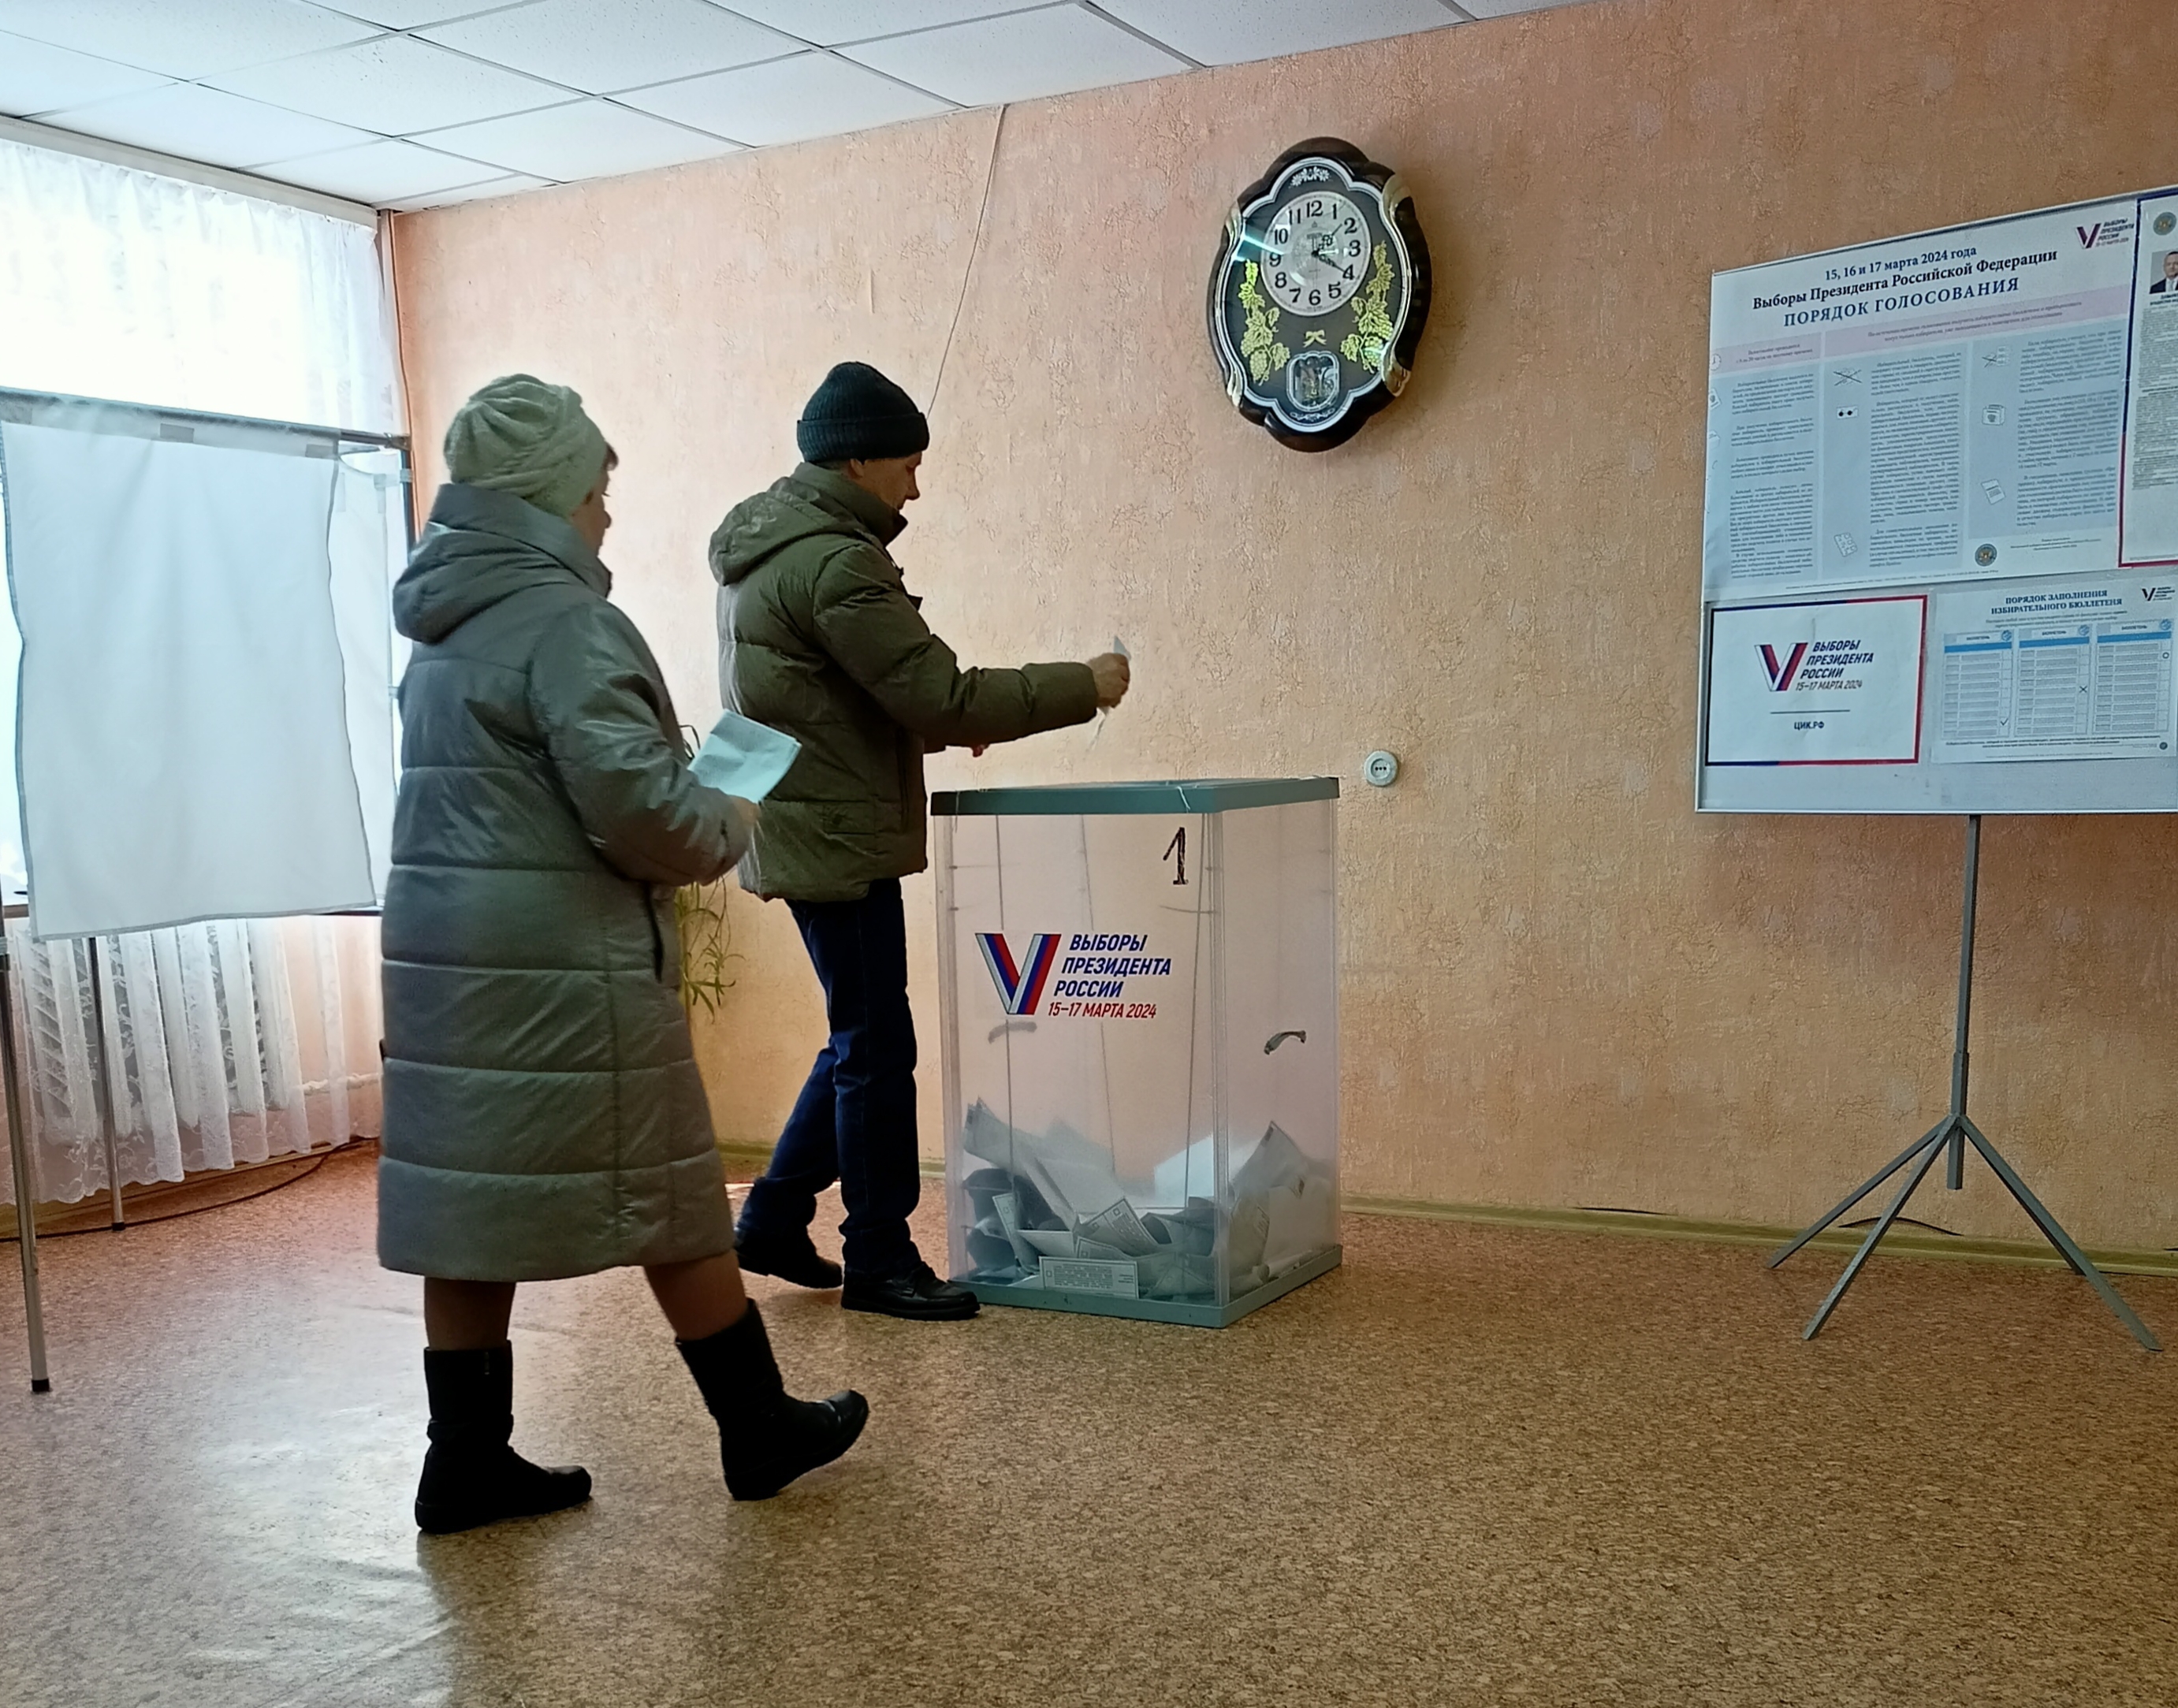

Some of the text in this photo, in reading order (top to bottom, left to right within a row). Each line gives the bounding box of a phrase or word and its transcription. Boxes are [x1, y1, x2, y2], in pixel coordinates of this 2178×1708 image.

[1289, 208, 1301, 225] 11
[1306, 200, 1323, 218] 12
[1332, 203, 1338, 220] 1
[1344, 218, 1357, 234] 2
[1275, 228, 1288, 245] 10
[1349, 240, 1361, 257] 3
[1269, 252, 1282, 267] 9
[1826, 247, 1977, 281] 15, 16 и 17 марта 2024 года
[1275, 272, 1287, 288] 8
[1342, 264, 1355, 280] 4
[1753, 251, 2058, 310] Выборы Президента Российской Федерации
[1289, 288, 1301, 303] 7
[1309, 289, 1321, 306] 6
[1328, 281, 1341, 299] 5
[1784, 301, 1869, 326] ПОРЯДОК
[1875, 277, 2019, 313] ГОЛОСОВАНИЯ
[2005, 590, 2108, 605] ПОРЯДОК ЗАПОЛНЕНИЯ
[1991, 602, 2068, 615] ИЗБИРАТЕЛЬНОГО
[1812, 640, 1861, 653] ВЫБОРЫ
[1806, 653, 1874, 666] ПРЕЗИДЕНТА
[1800, 668, 1844, 679] РОССИИ
[1818, 680, 1843, 690] МАРТА
[1844, 679, 1863, 690] 2024
[1794, 720, 1825, 731] ЦИК.РФ
[1163, 827, 1189, 885] 1
[1069, 934, 1148, 951] ВЫБОРЫ
[1061, 957, 1171, 977] ПРЕЗИДЕНТА
[1053, 980, 1124, 998] РОССИИ
[1084, 1003, 1124, 1018] МАРТА
[1126, 1003, 1157, 1018] 2024
